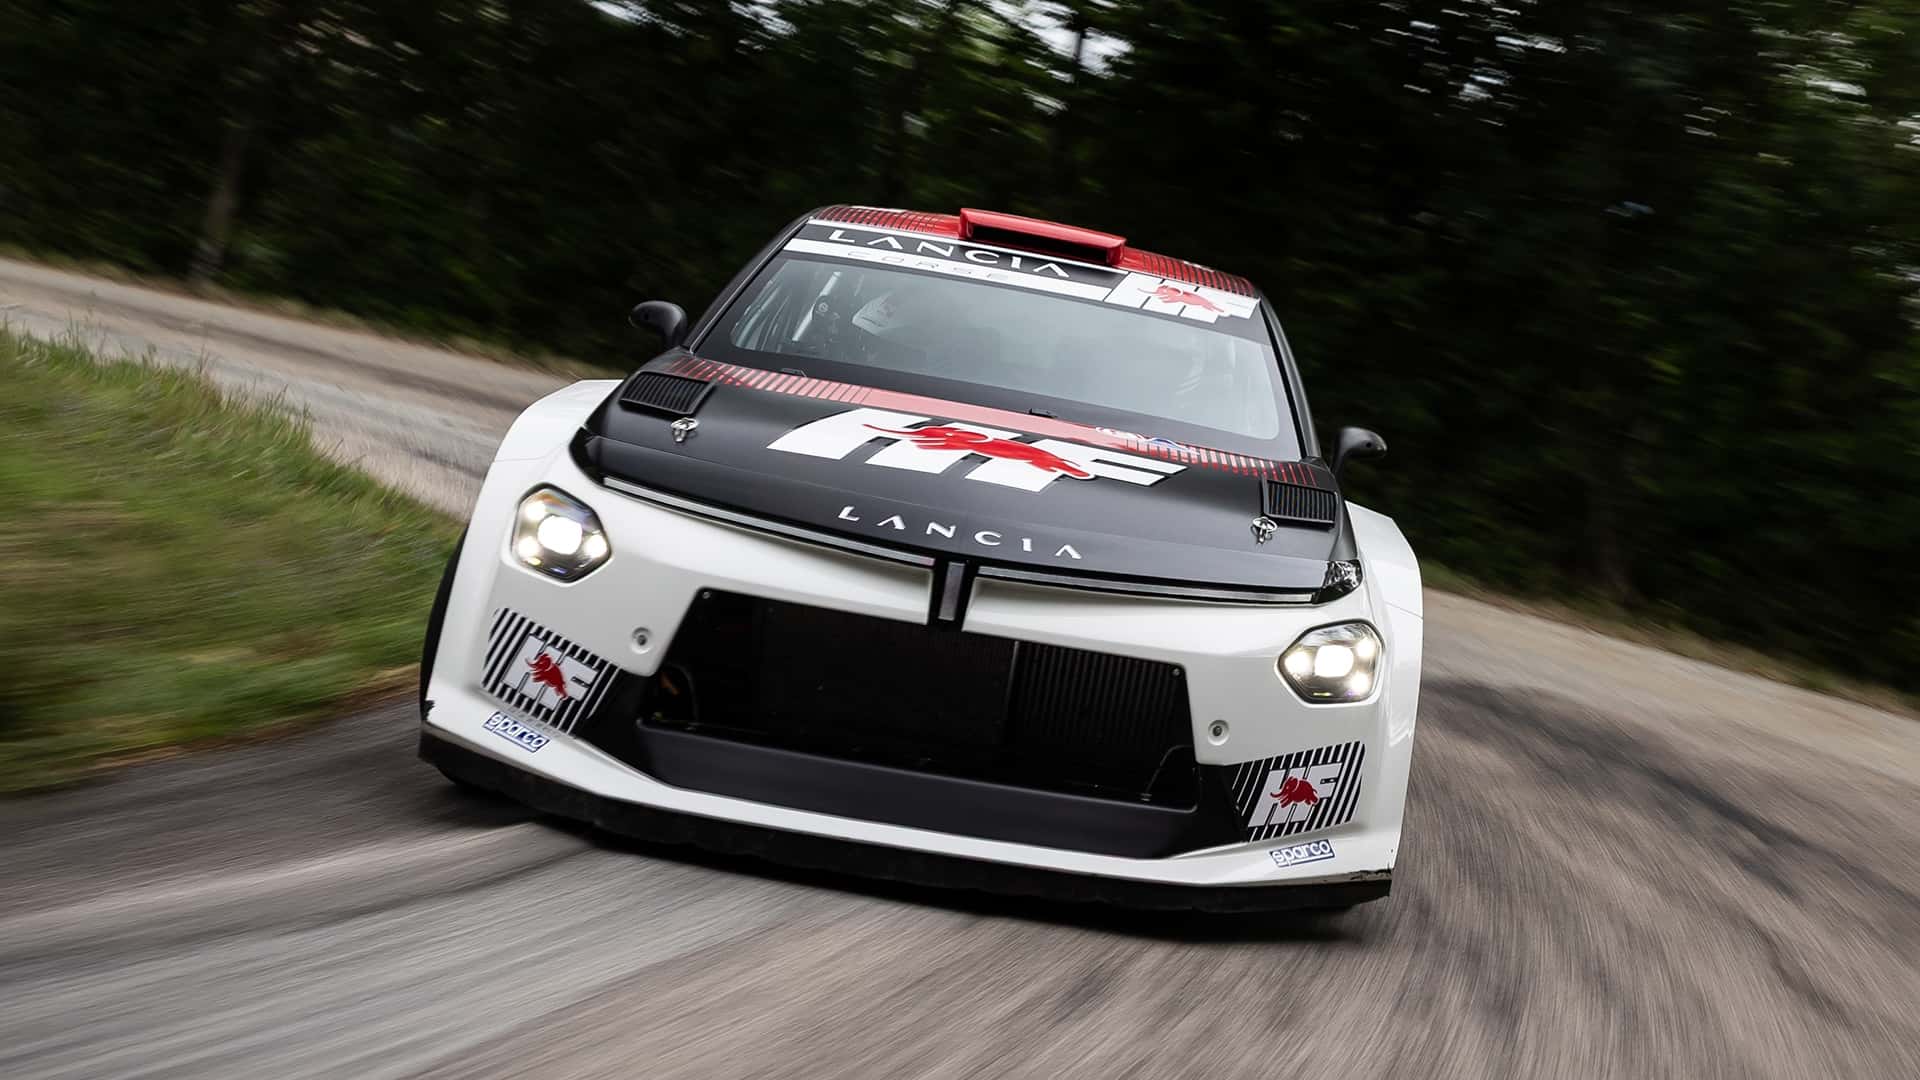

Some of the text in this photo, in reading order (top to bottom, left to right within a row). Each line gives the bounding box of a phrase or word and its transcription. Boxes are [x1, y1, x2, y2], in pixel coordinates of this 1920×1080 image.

[829, 230, 1070, 278] LANCIA
[837, 505, 1082, 560] LANCIA
[486, 714, 548, 749] sparco
[1271, 840, 1331, 867] sparco
